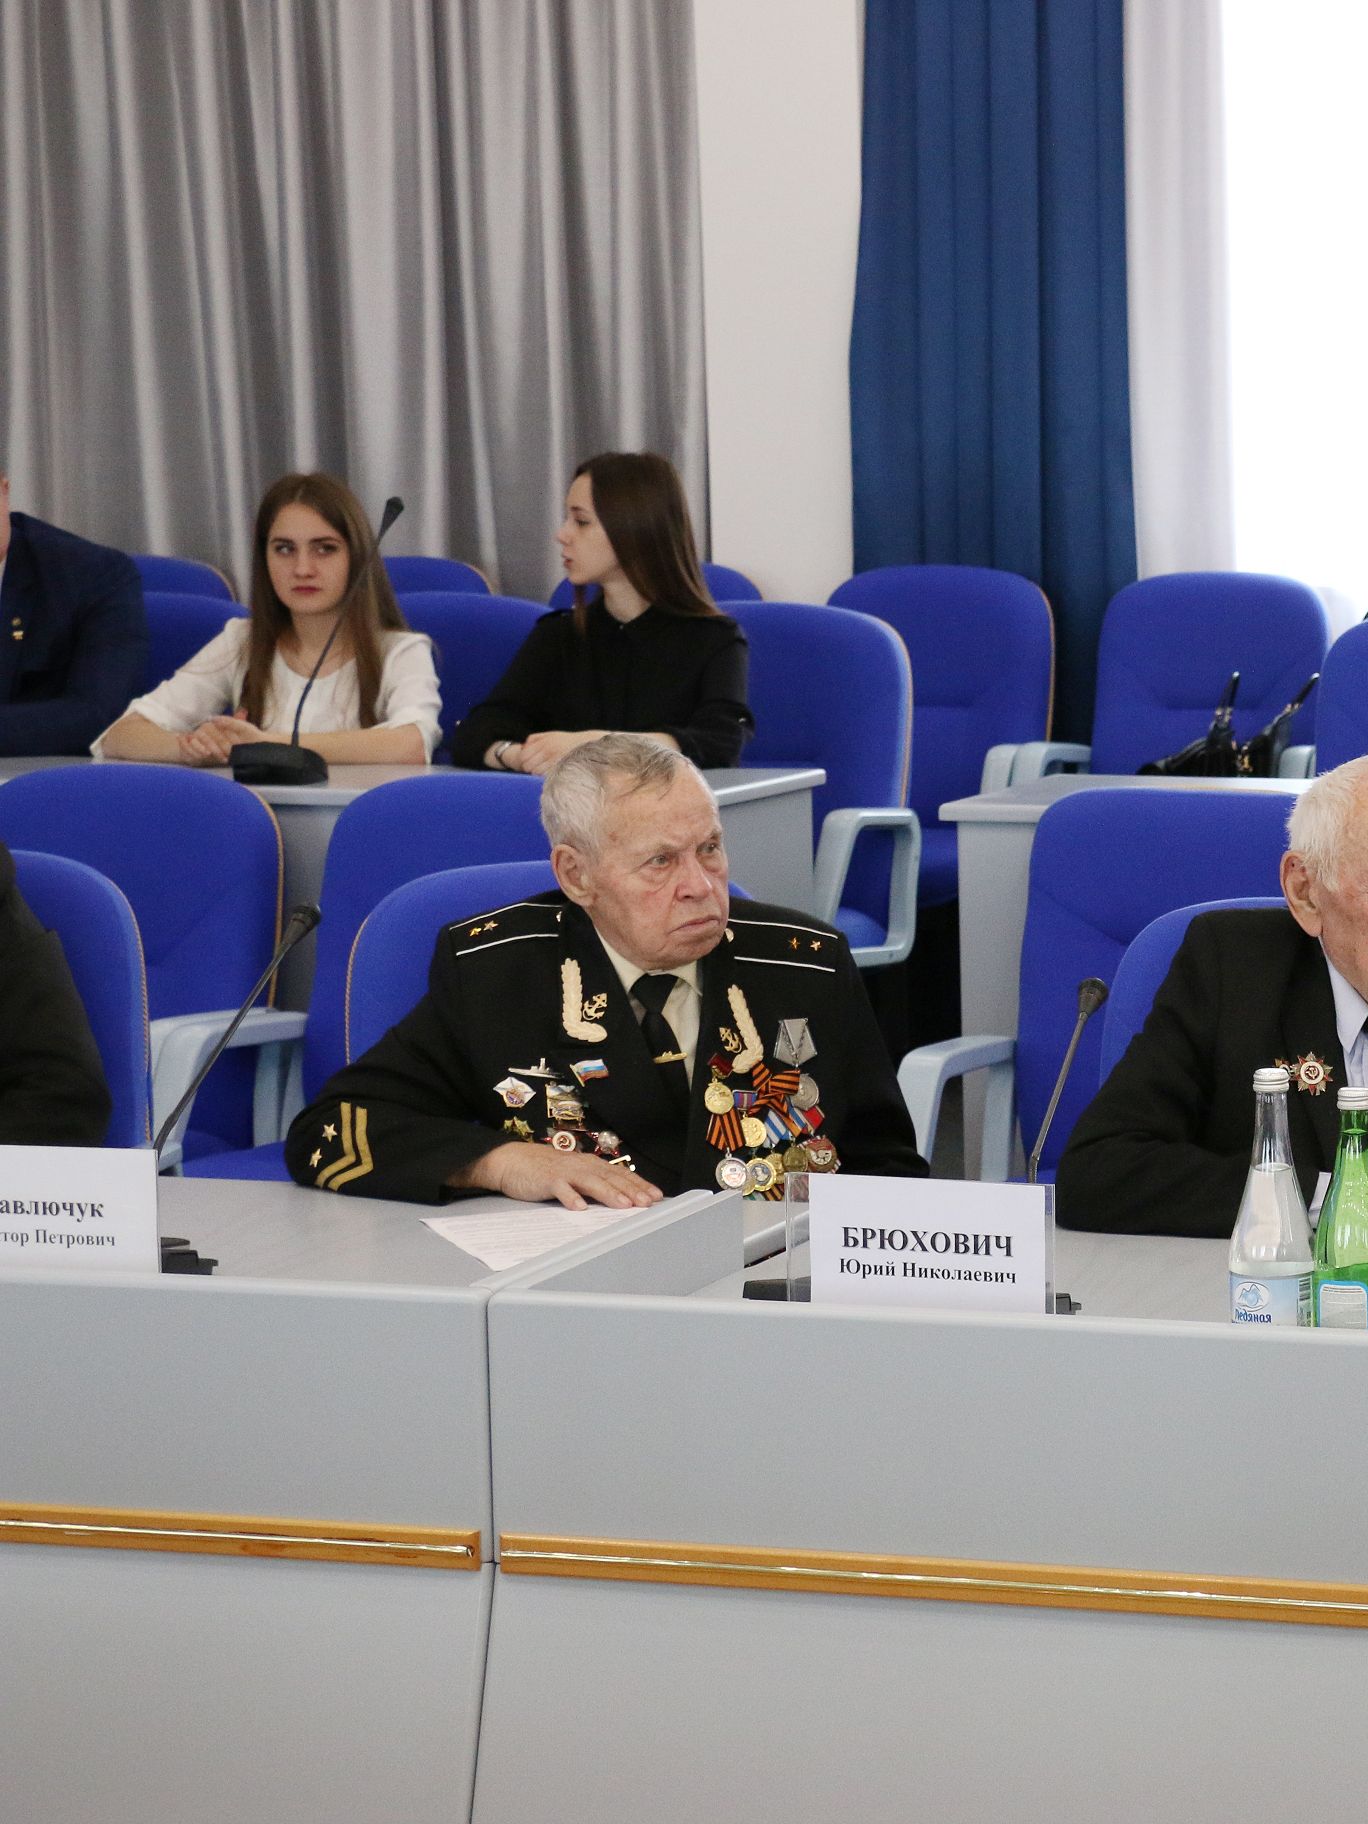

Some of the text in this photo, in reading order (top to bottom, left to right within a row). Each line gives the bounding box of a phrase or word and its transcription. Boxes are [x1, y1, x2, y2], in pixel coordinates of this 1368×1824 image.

[35, 1229, 116, 1249] Петрович
[841, 1226, 1014, 1258] БРЮХОВИЧ
[839, 1258, 1017, 1285] Юрий Николаевич
